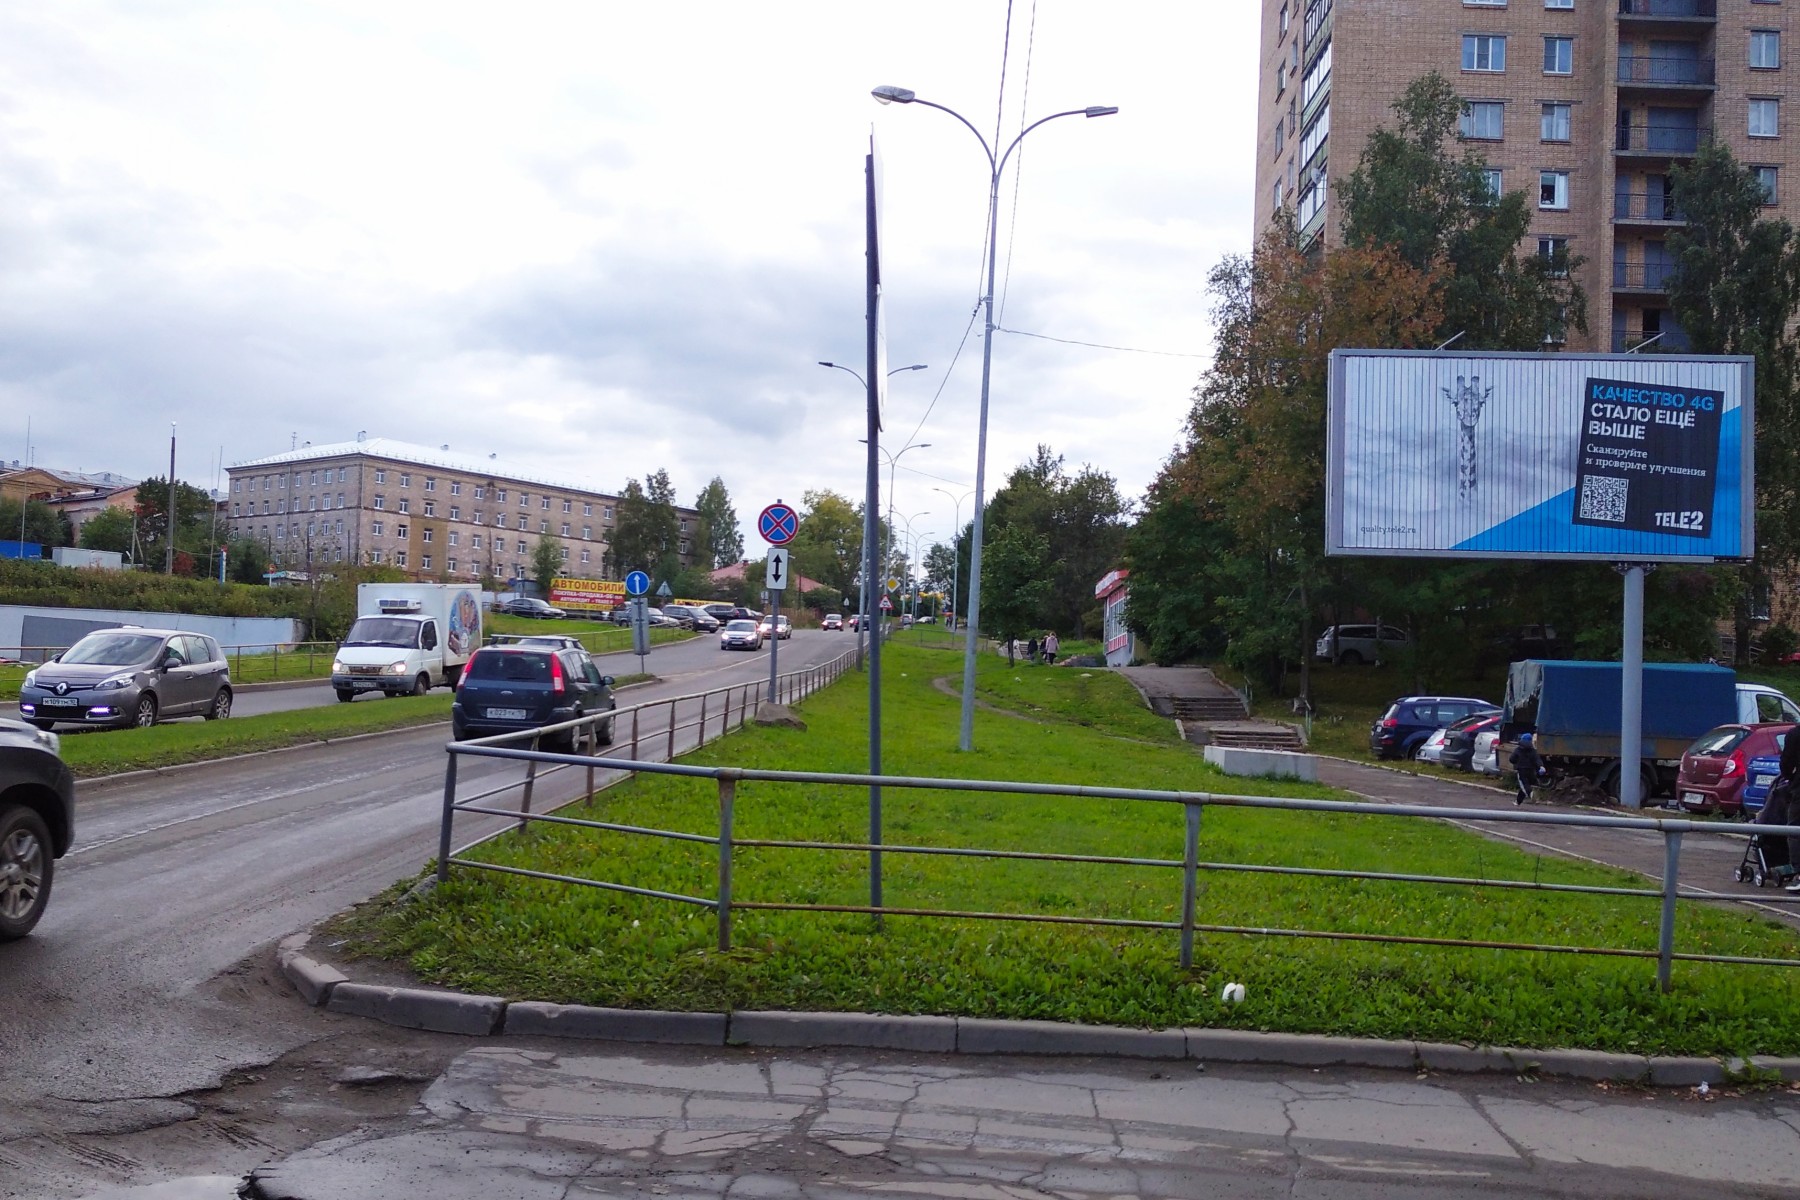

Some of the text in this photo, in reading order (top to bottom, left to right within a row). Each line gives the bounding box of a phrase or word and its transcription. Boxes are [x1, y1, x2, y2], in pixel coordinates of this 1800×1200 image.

[1592, 384, 1715, 411] КАЧЕСТВО 4G
[1591, 402, 1696, 429] СТАЛО ЕЩЁ
[1588, 420, 1646, 440] ВЫШЕ
[1586, 443, 1649, 459] Сканируйте
[1585, 457, 1707, 477] и проверьте улучшения
[1654, 510, 1704, 530] TELE2
[553, 580, 625, 593] АВТОМОБИЛИ
